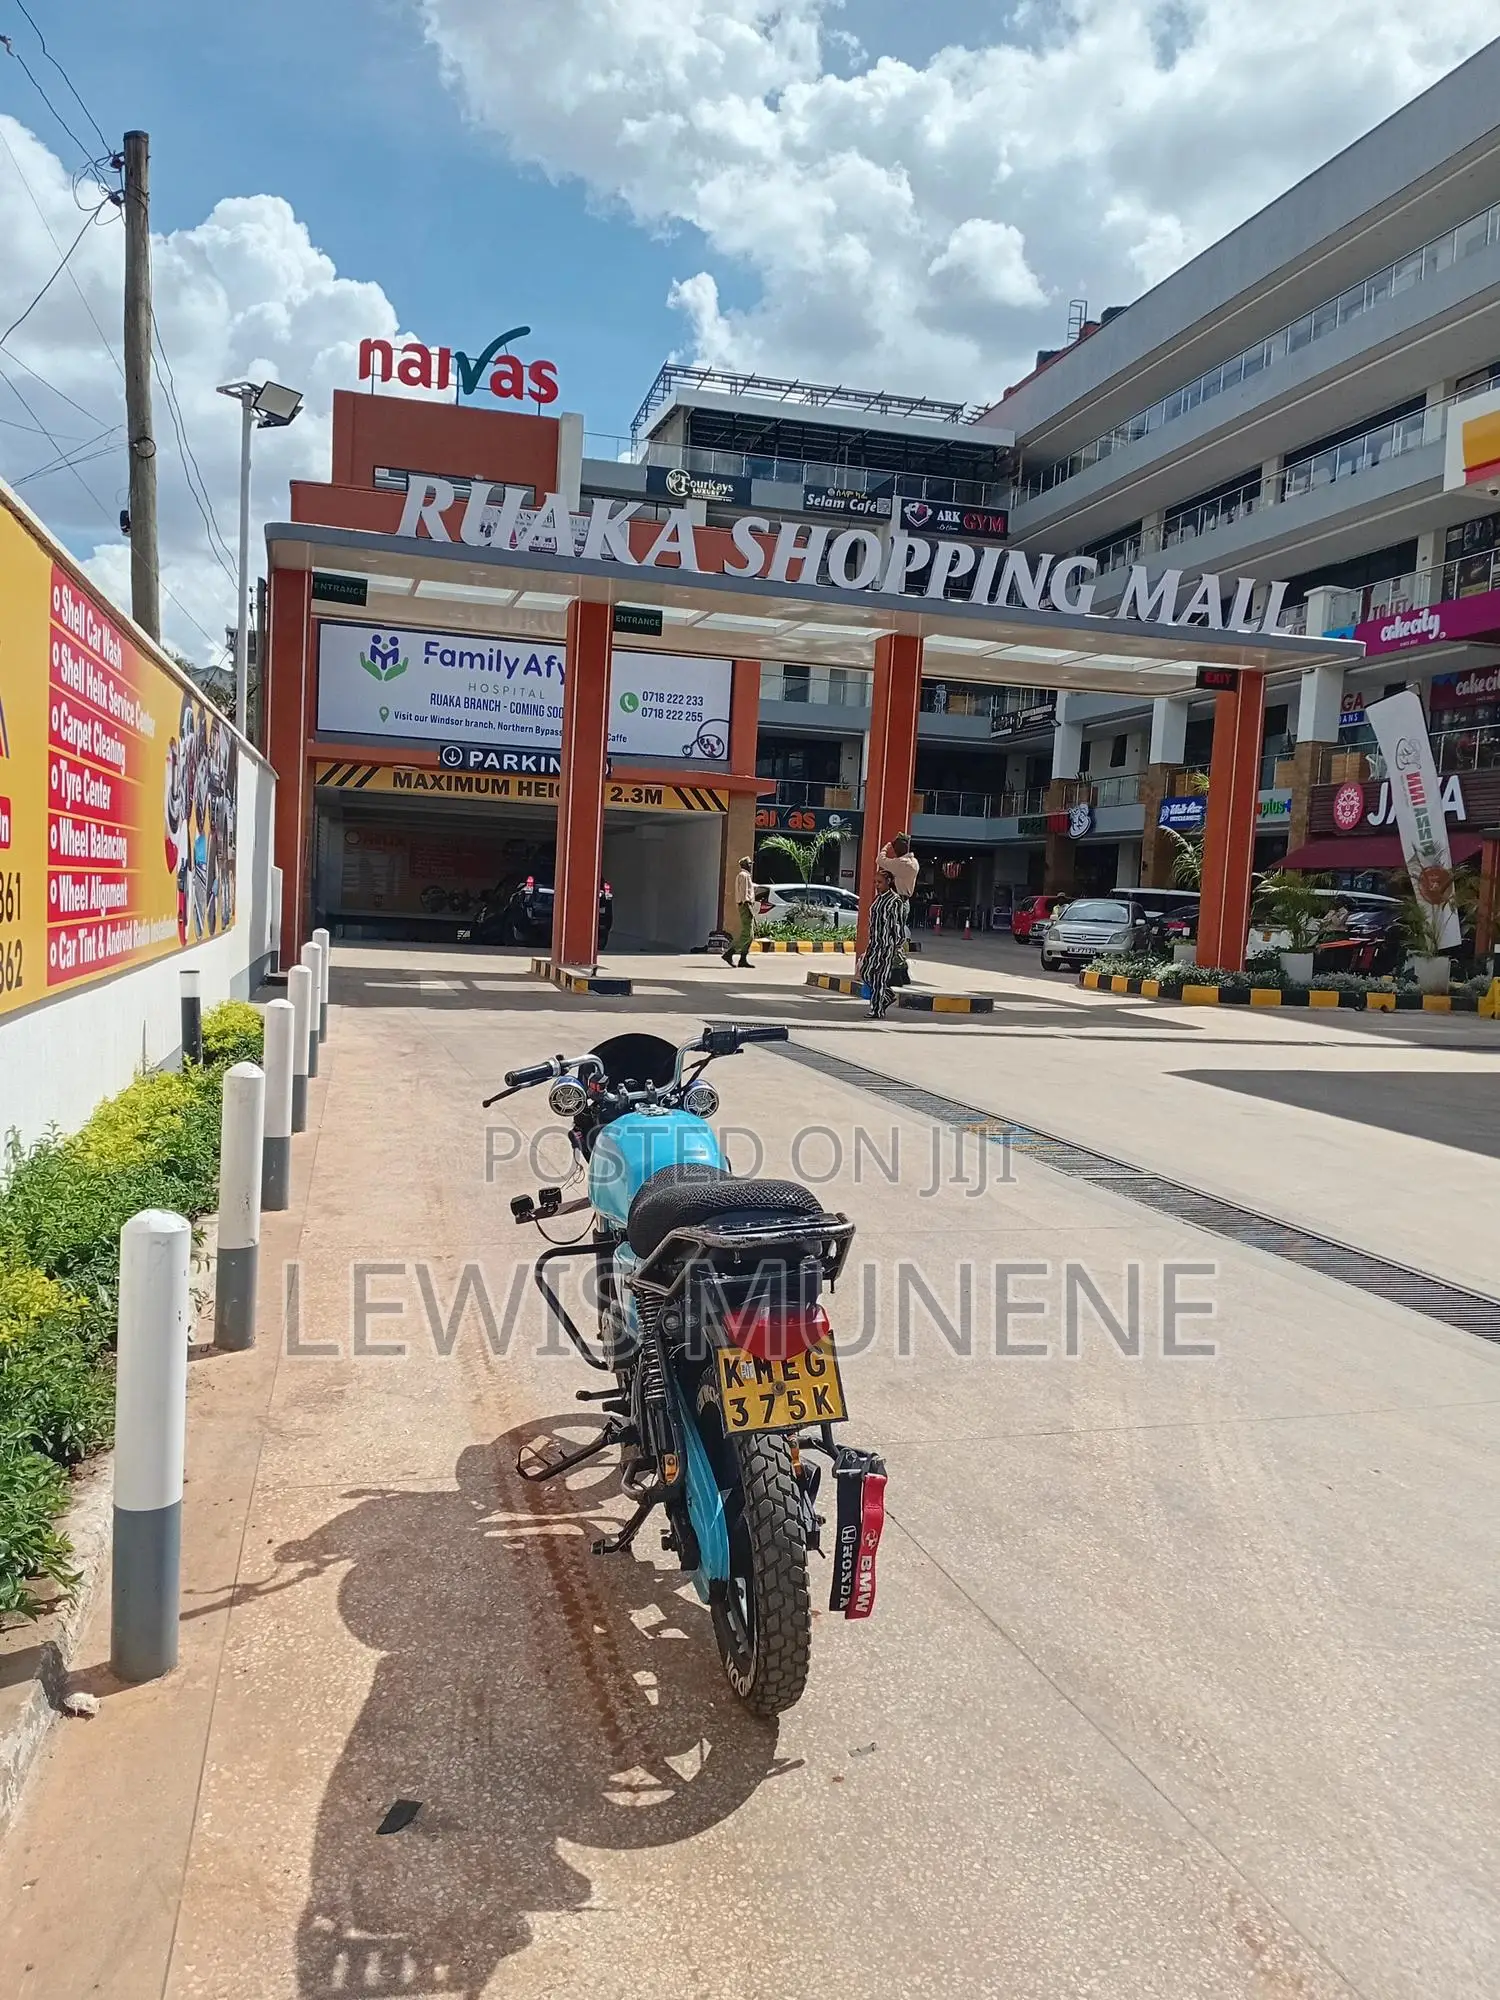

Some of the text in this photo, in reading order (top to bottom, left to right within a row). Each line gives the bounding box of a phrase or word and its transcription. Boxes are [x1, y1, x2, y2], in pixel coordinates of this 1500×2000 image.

[359, 325, 559, 404] naivas
[806, 493, 877, 514] Selam Café
[937, 510, 960, 523] ARK
[963, 512, 1004, 533] GYM
[395, 475, 701, 571] RUAKA
[722, 515, 1099, 615] SHOPPING
[1116, 565, 1291, 635] MALL
[314, 581, 367, 597] ENTRANCE
[62, 584, 122, 672] Shell Car Wash
[616, 614, 660, 627] ENTRANCE
[61, 642, 85, 695] Shell
[86, 662, 108, 710] Helix
[109, 679, 135, 727] Service
[424, 640, 566, 686] Family Afy
[1204, 671, 1232, 685] EXIT
[430, 692, 462, 709] RUAKA
[463, 697, 501, 713] BRANCH
[509, 700, 545, 718] COMING
[546, 705, 564, 720] SOO
[468, 682, 546, 700] HOSPITAL
[642, 690, 704, 707] 0718 222 233
[1341, 691, 1364, 712] GA
[394, 710, 413, 722] Visit
[414, 714, 429, 724] our
[430, 714, 464, 727] Windsor
[465, 718, 496, 731] branch,
[497, 721, 534, 734] Northern
[535, 724, 563, 738] Bypass
[641, 707, 703, 723] 0718 222 255
[1339, 712, 1359, 723] ANS
[60, 701, 92, 757] Carpet
[93, 720, 126, 777] Cleaning
[59, 758, 112, 811] Tyre Center
[393, 771, 510, 796] MAXIMUM
[610, 786, 663, 805] 2.3M
[1366, 774, 1467, 827] JA
[755, 803, 816, 830] aivas
[59, 816, 128, 868] Wheel Balancing
[59, 874, 128, 918] Wheel Alignment
[59, 931, 77, 970] Car
[78, 926, 96, 964] Tint
[98, 925, 104, 959] &
[106, 919, 133, 957] Android
[722, 1345, 827, 1390] KMEG
[729, 1383, 836, 1428] 375K
[840, 1544, 853, 1609] HONDA
[855, 1555, 873, 1613] BMW
